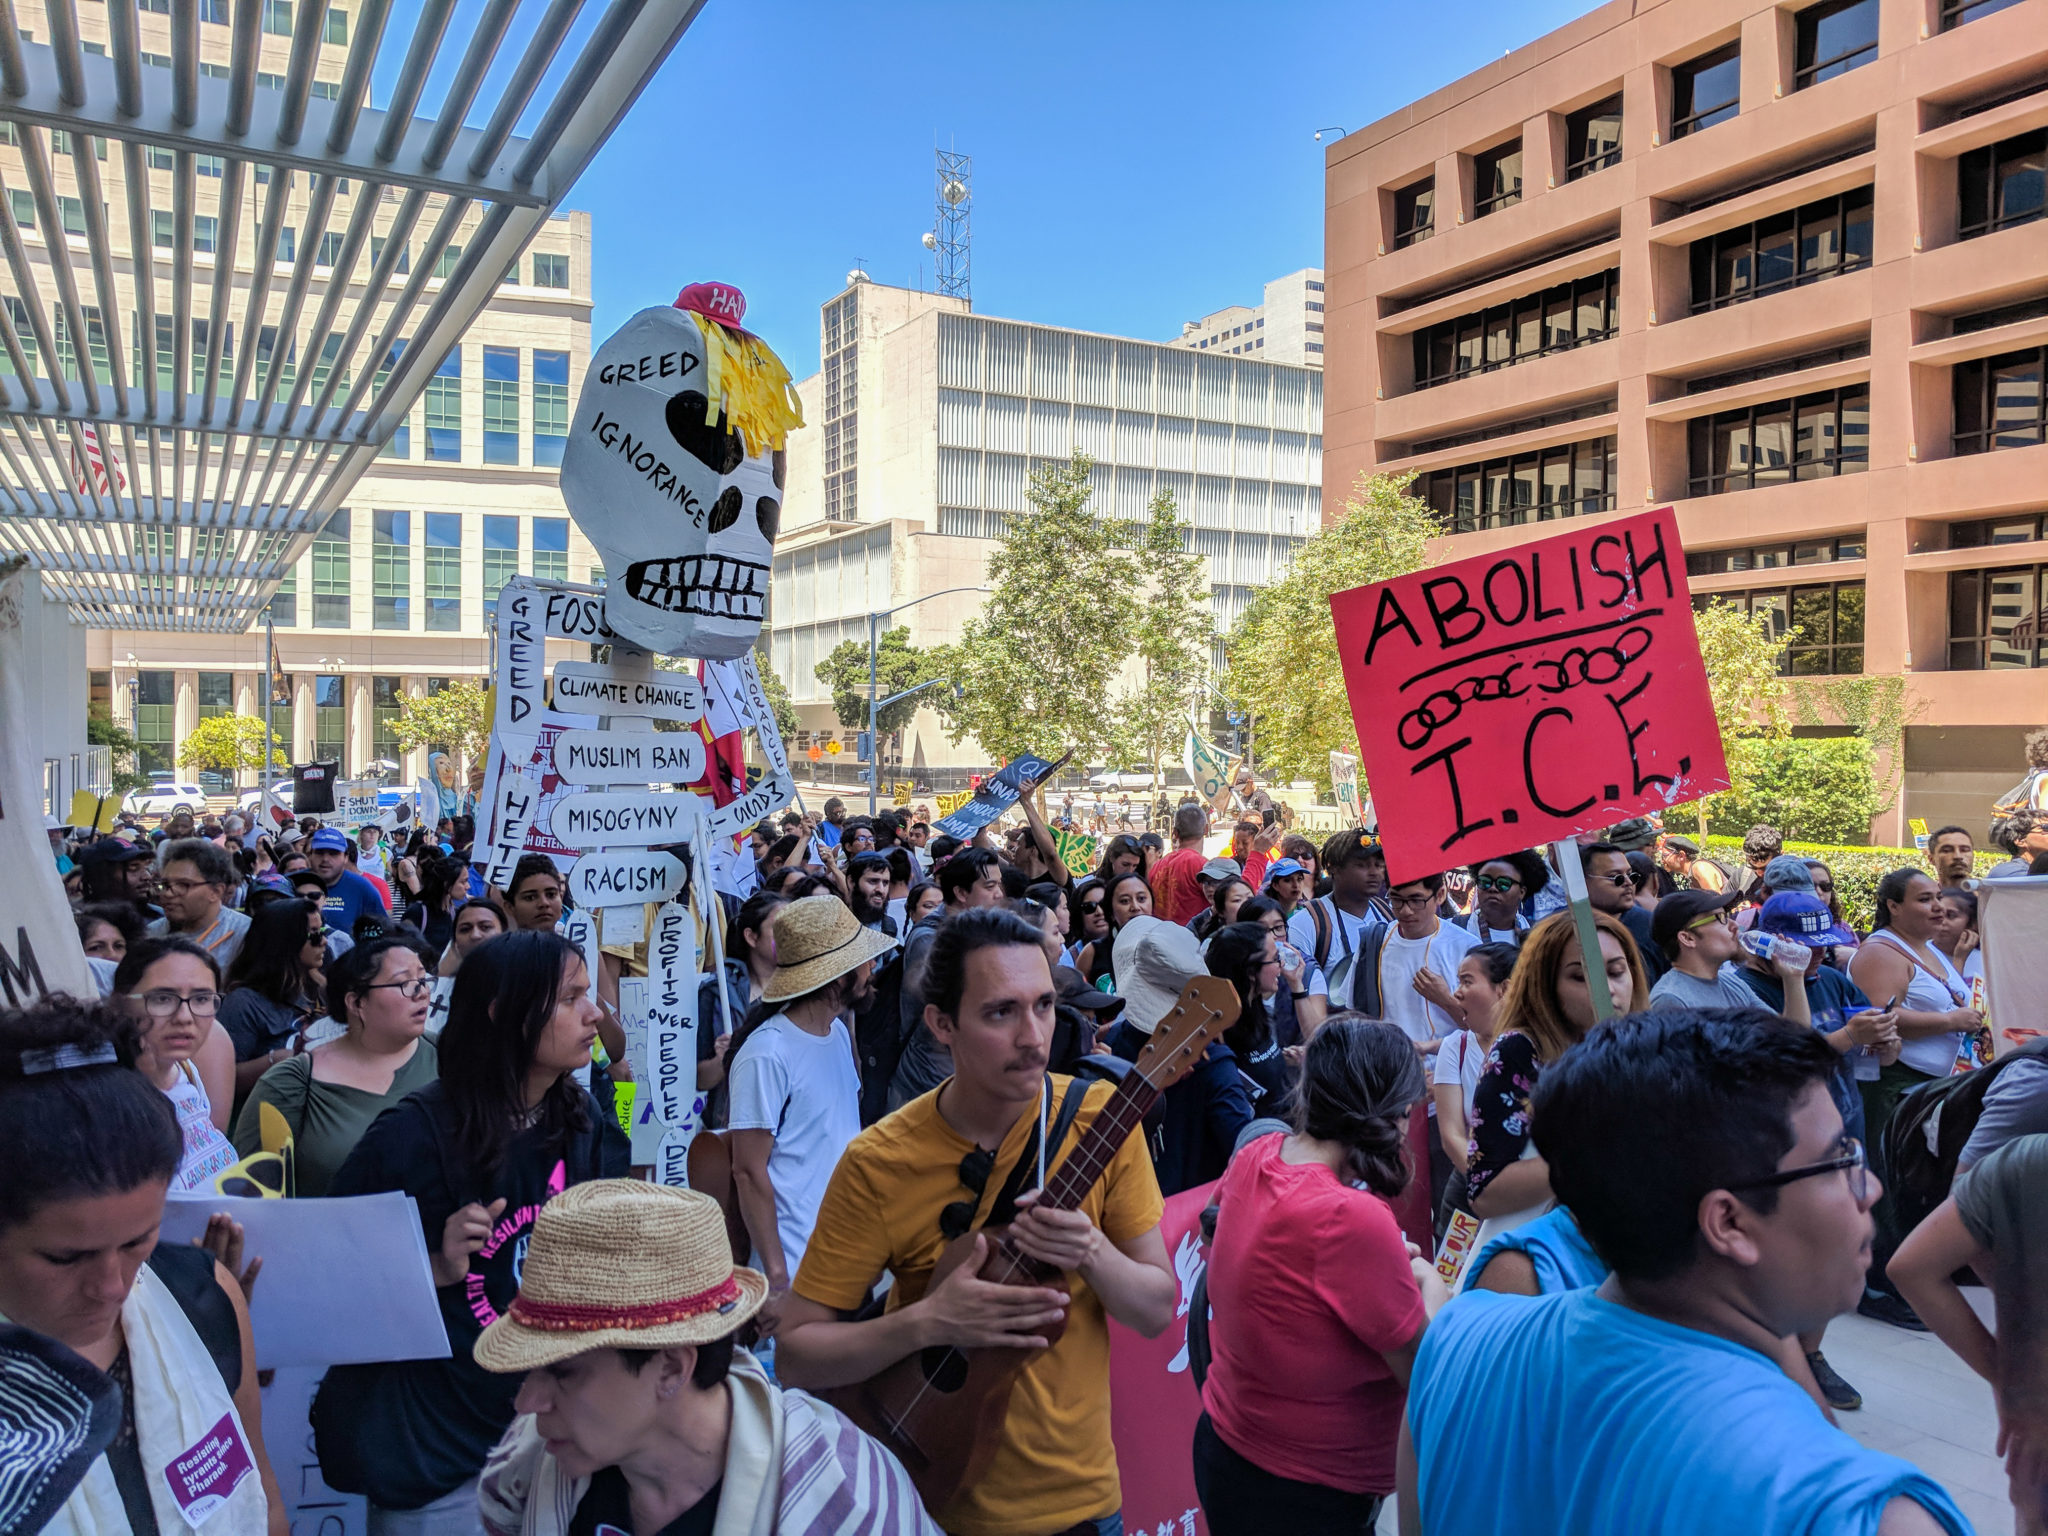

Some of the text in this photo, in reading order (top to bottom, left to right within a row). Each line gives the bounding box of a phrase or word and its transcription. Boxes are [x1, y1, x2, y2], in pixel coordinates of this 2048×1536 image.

[600, 351, 700, 386] GREED
[591, 411, 706, 529] IGNORANCE
[1364, 523, 1674, 665] ABOLISH
[510, 596, 535, 723] GREED
[559, 677, 697, 710] CLIMATE CHANGE
[569, 745, 691, 770] MUSLIM BAN
[1411, 672, 1691, 851] I.C.E.
[348, 797, 376, 806] SHUT
[568, 806, 678, 833] MISOGYNY
[584, 864, 666, 896] RACISM
[659, 915, 682, 1007] PROFITS
[648, 1008, 693, 1030] OVER
[659, 1033, 679, 1122] PEOPLE
[466, 1272, 499, 1328] EALTHY
[177, 1436, 220, 1475] Resisting
[182, 1455, 218, 1487] tyrants
